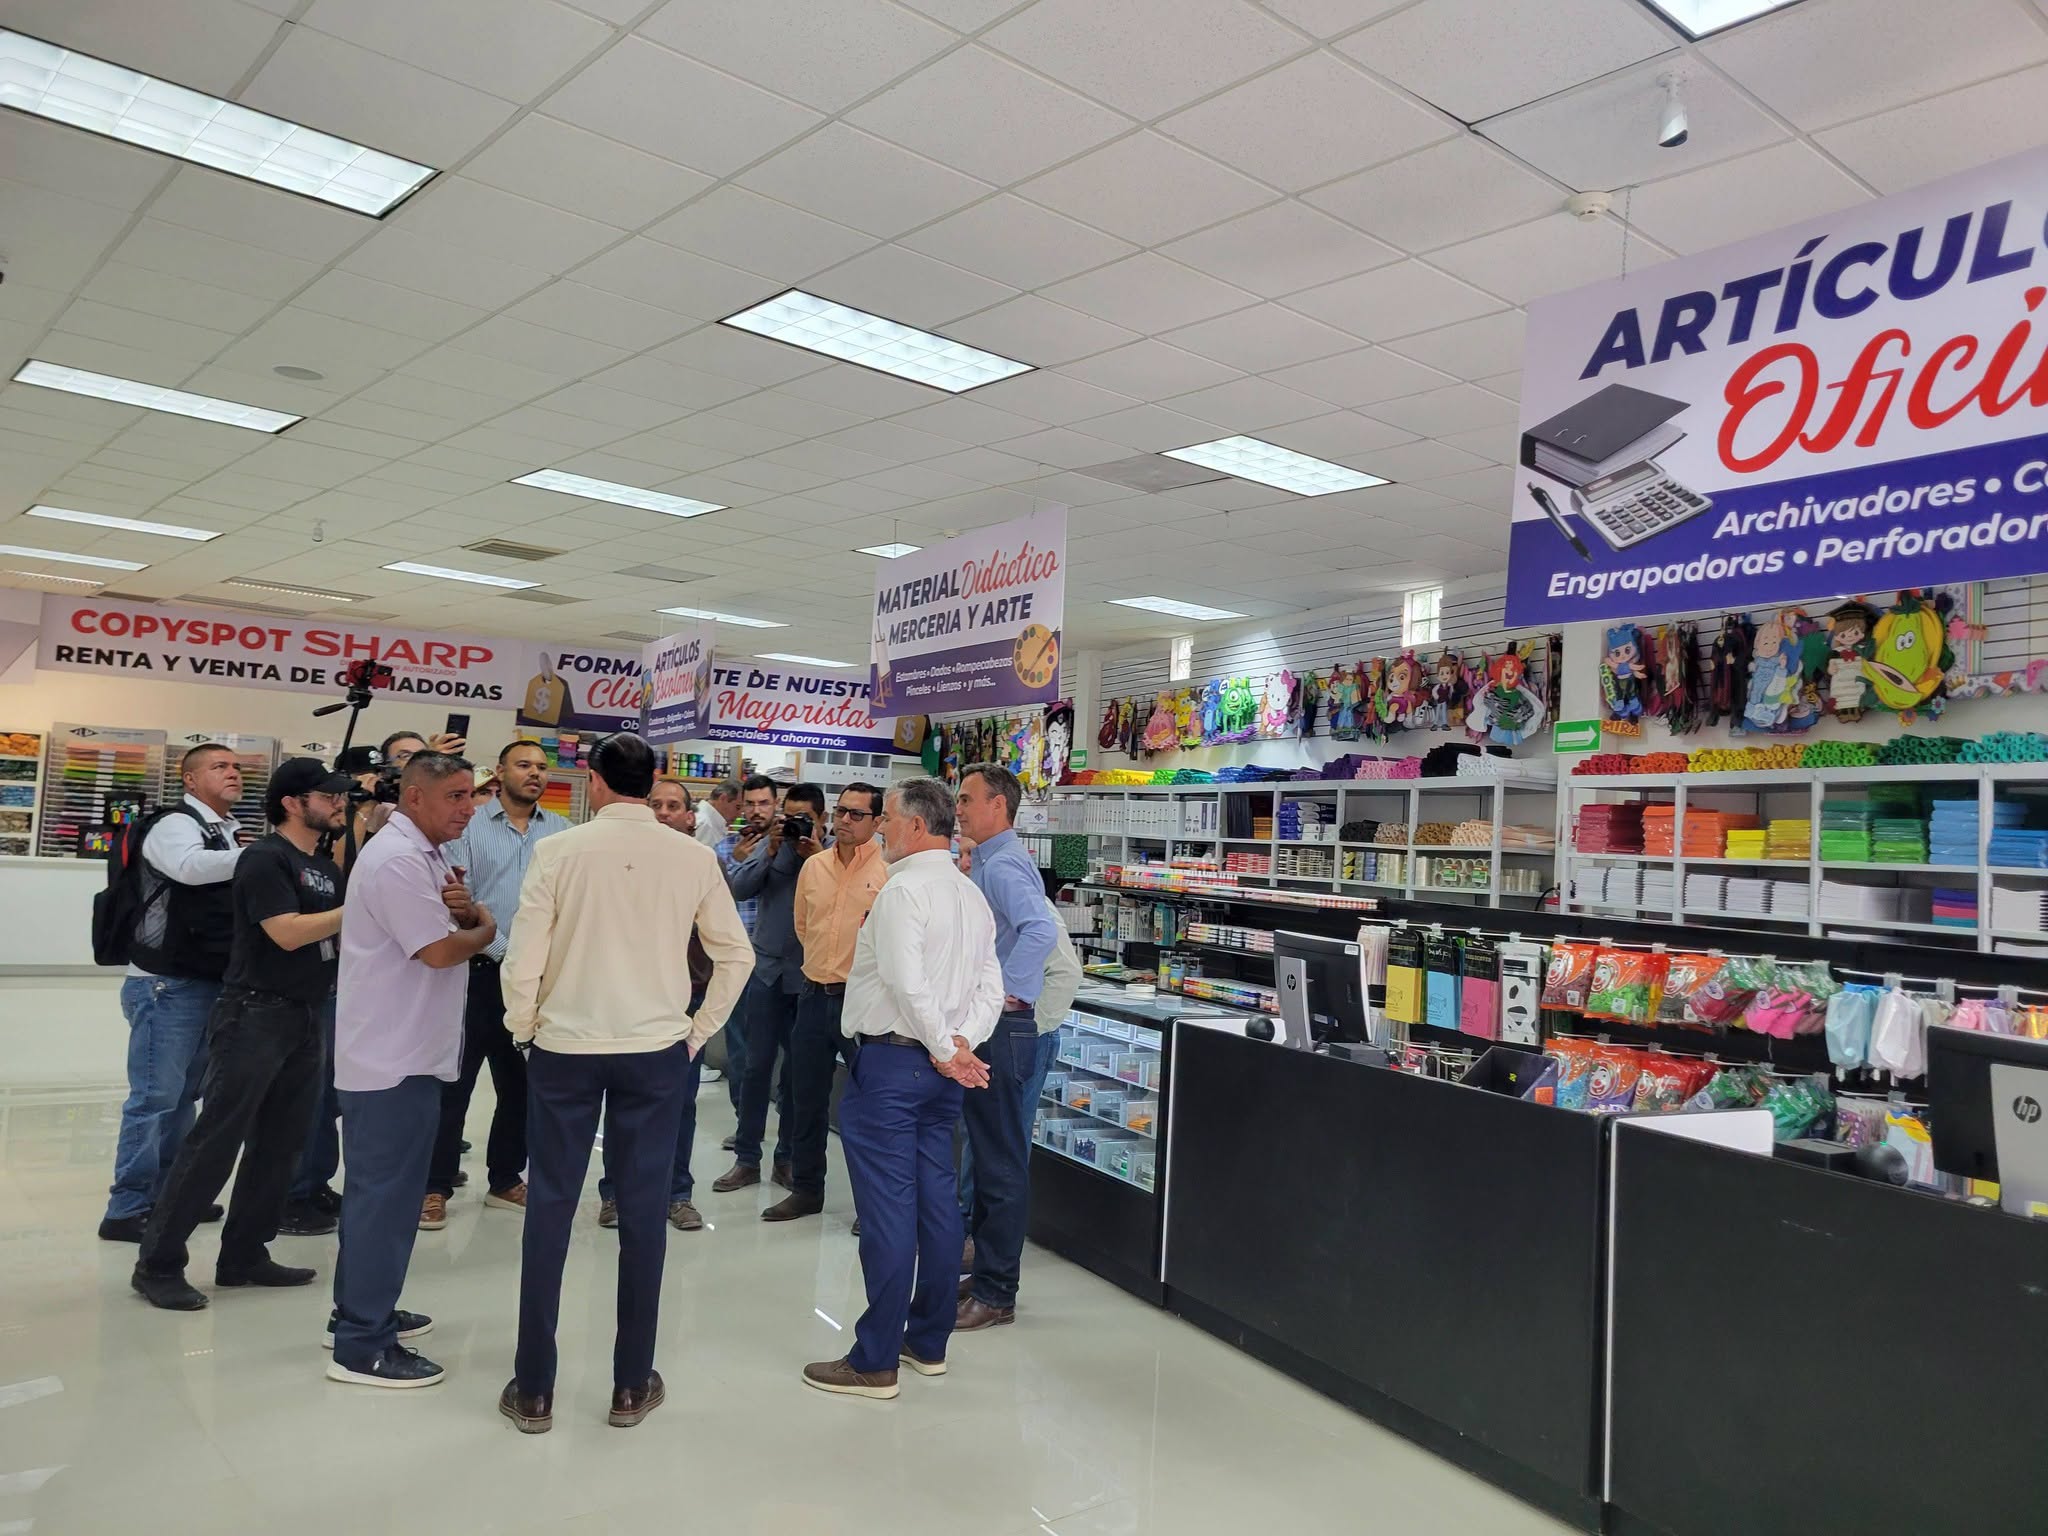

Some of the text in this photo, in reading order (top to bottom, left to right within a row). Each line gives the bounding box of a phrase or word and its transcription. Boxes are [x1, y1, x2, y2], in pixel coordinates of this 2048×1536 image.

[1578, 199, 2048, 380] ARTÍCUL
[1712, 478, 1977, 539] Archivadores
[1547, 512, 2048, 598] Engrapadoras Perforador
[877, 541, 1060, 616] MATERIAL Didáctico
[71, 609, 494, 669] COPYSPOT SHARP
[888, 592, 1034, 646] MERCERIA Y ARTE
[56, 644, 503, 700] RENTA Y VENTA DE CIADORAS
[402, 665, 457, 676] AUTORIZADO
[654, 638, 700, 674] ARTÍCULOS
[956, 656, 1013, 674] Rompecabezas
[747, 671, 780, 690] DE
[786, 676, 871, 699] NUESTR
[905, 684, 932, 696] Pinceles
[967, 680, 974, 692] y
[718, 690, 879, 731] Mayoristas
[708, 728, 770, 741] especiales
[771, 731, 781, 743] y
[781, 733, 820, 745] ahorra
[822, 735, 847, 747] más
[2014, 1096, 2041, 1123] hp
